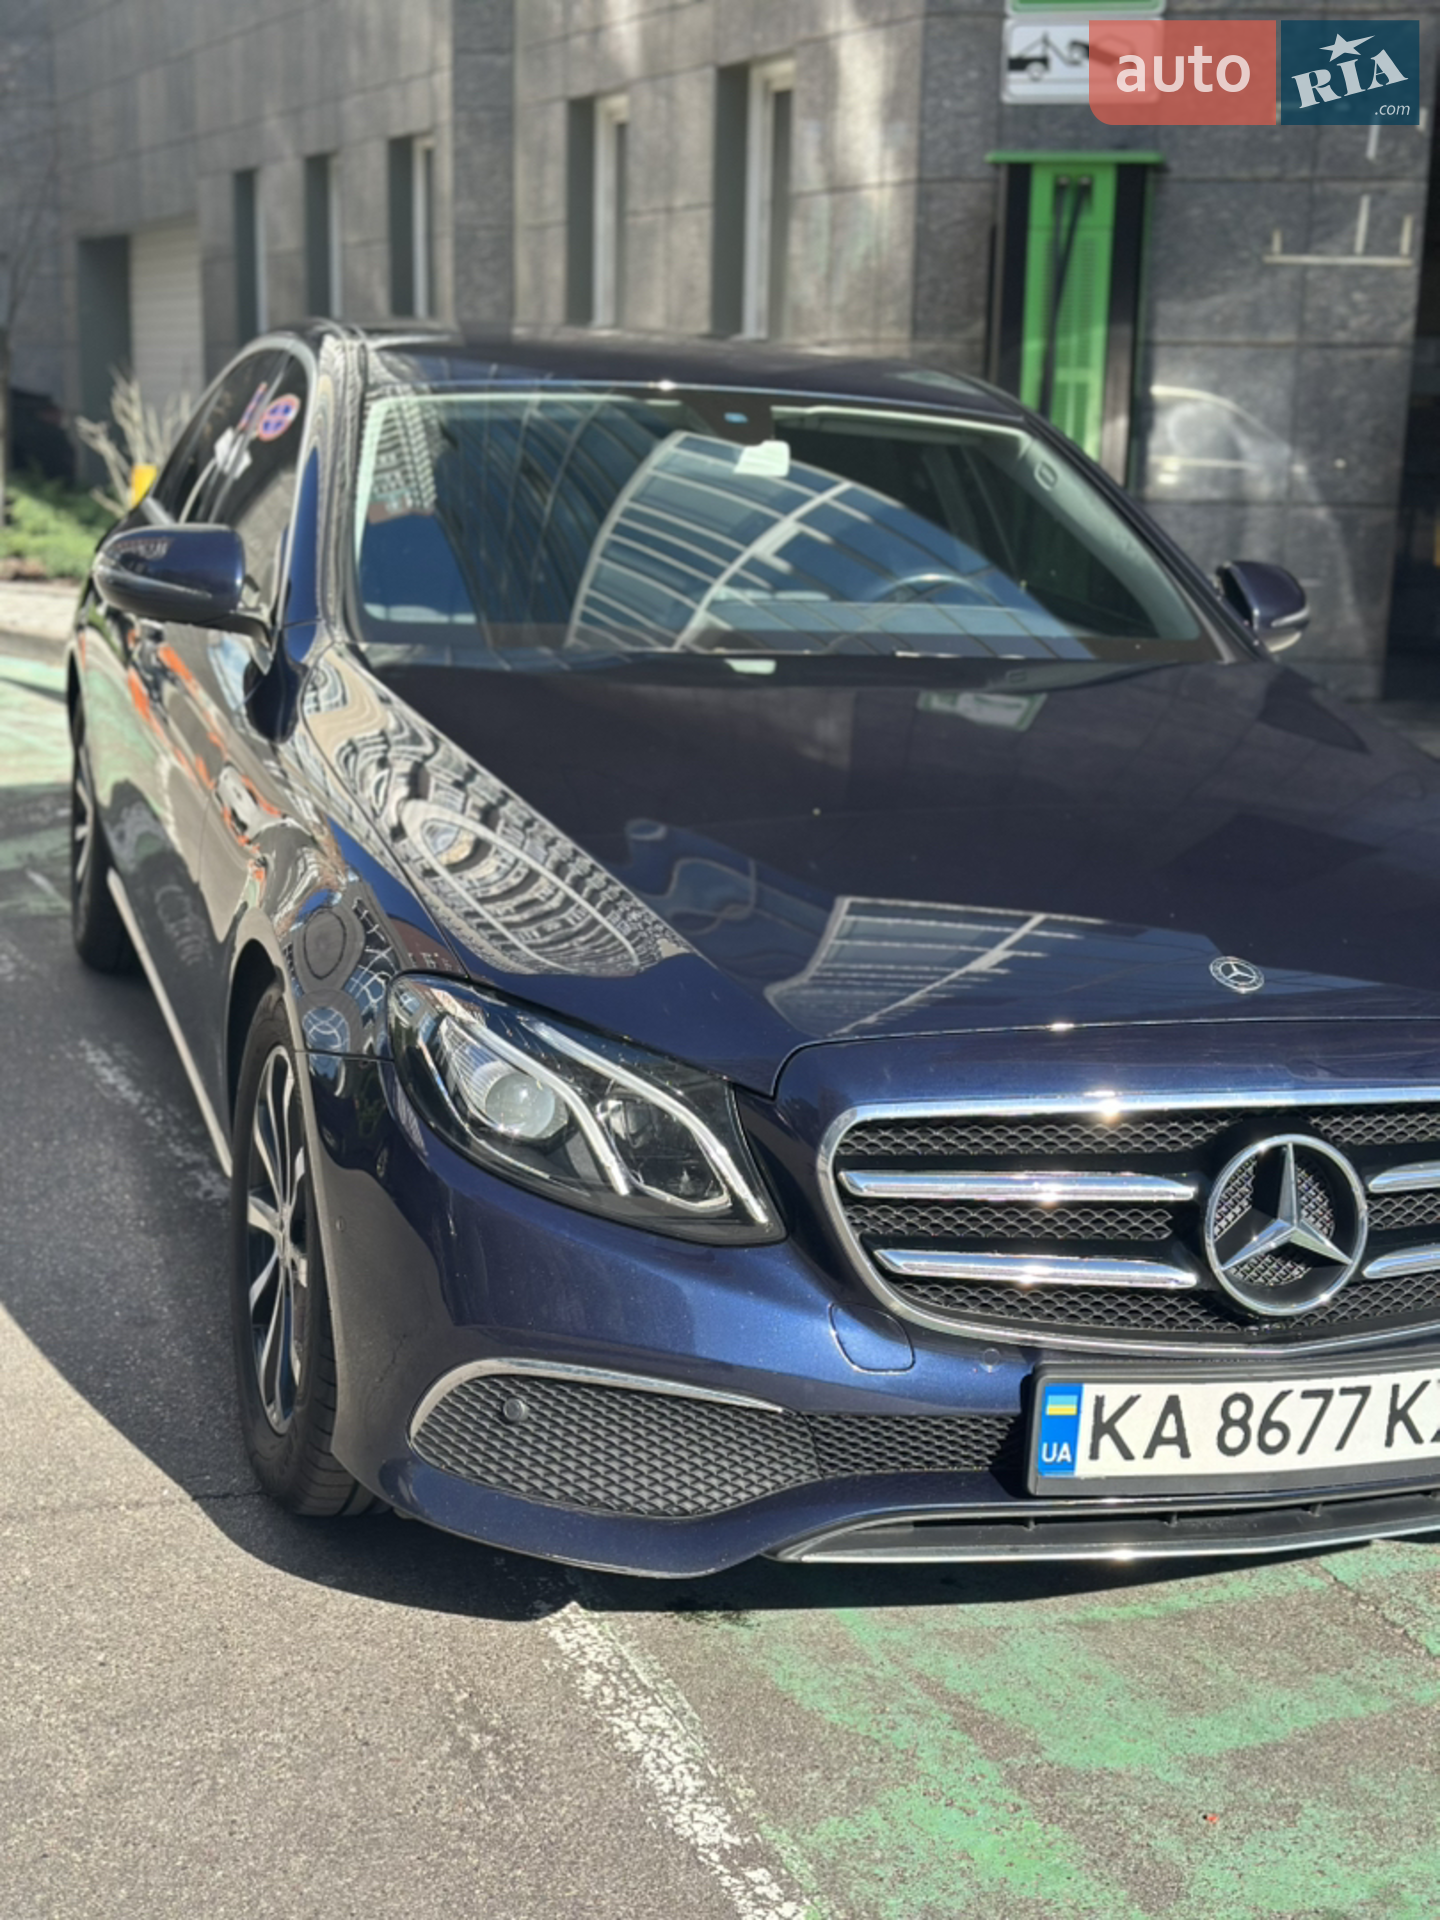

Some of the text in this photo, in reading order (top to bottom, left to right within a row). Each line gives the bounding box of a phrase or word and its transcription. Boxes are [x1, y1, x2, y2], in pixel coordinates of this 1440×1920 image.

[1088, 1379, 1440, 1461] KA 8677 K
[1042, 1442, 1072, 1463] UA
